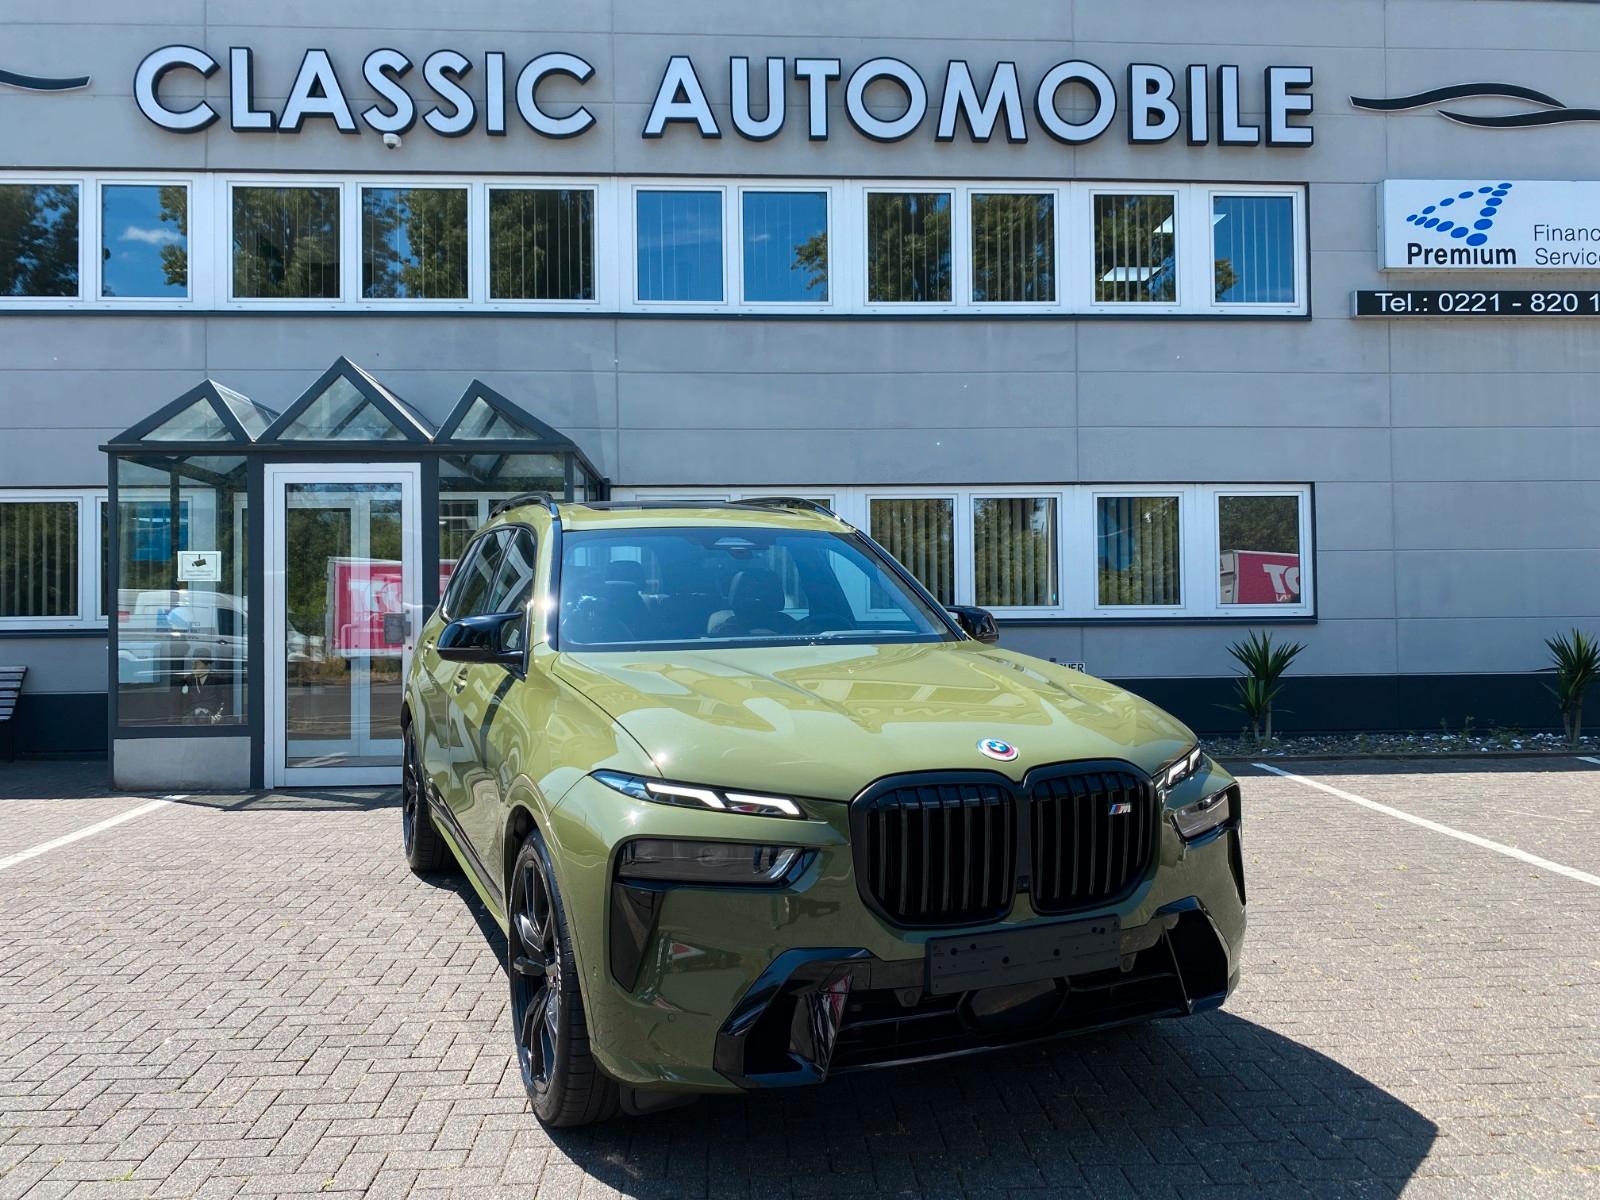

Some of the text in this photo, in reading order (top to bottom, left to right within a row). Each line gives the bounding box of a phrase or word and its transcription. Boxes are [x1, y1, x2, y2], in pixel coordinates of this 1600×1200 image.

[133, 44, 1314, 147] CLASSIC AUTOMOBILE
[1407, 243, 1516, 265] Premium
[1535, 247, 1600, 265] Servic
[1375, 293, 1428, 312] Tel.:
[1438, 293, 1500, 312] 0221
[1530, 293, 1579, 312] 820
